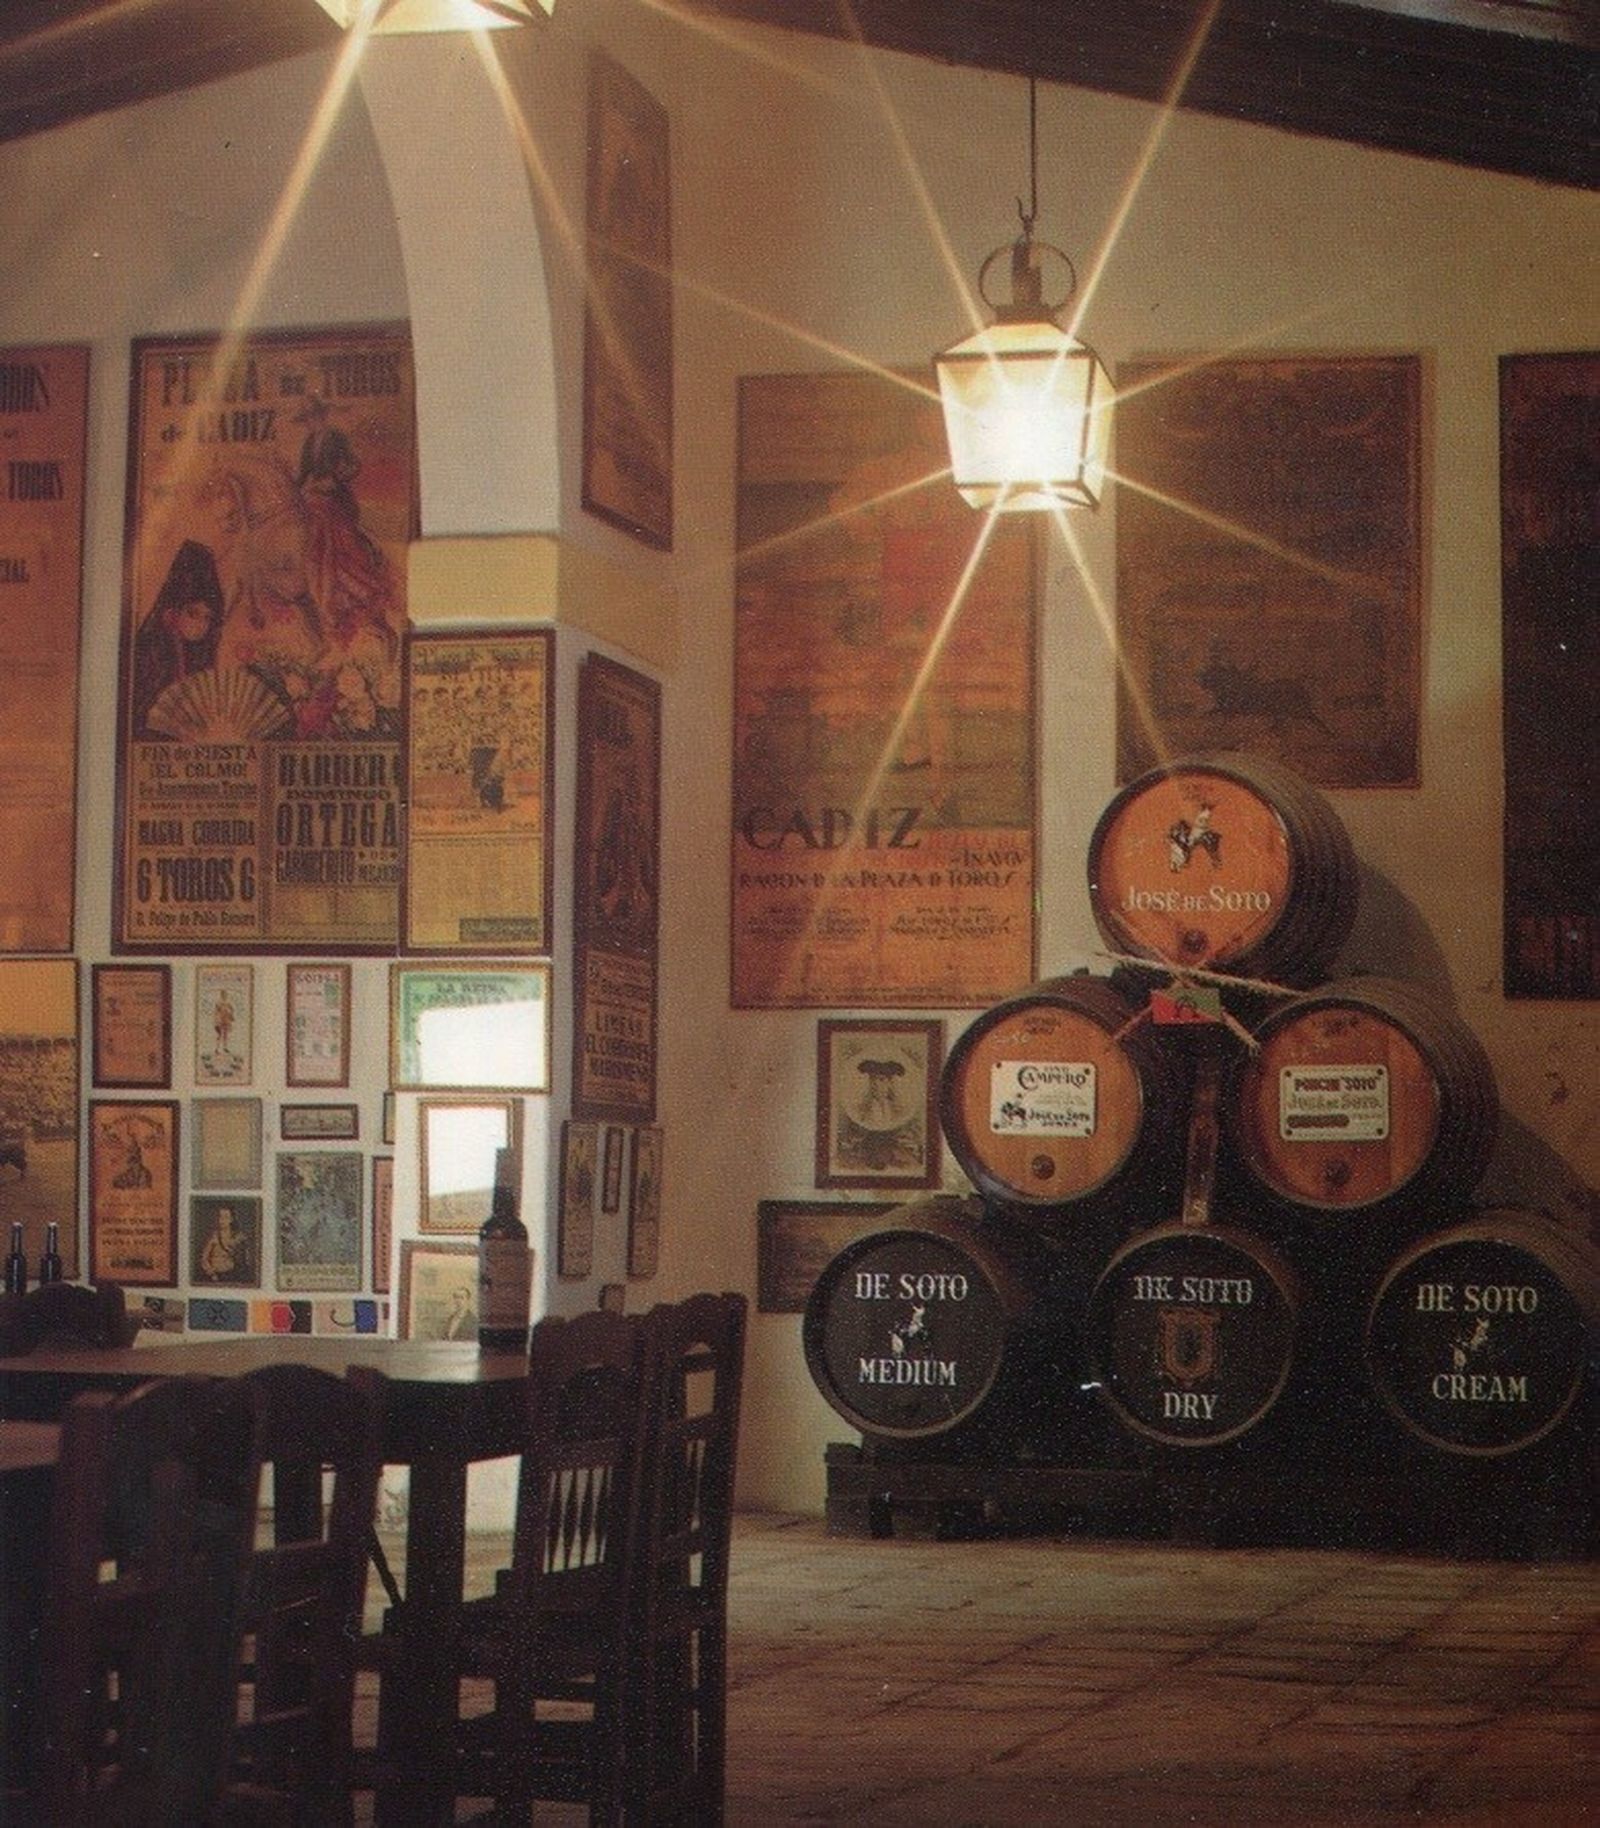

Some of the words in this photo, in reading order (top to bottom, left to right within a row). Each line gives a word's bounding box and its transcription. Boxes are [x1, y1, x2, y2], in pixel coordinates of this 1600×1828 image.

[161, 358, 259, 406] PLZA
[195, 744, 257, 761] FIESTA
[286, 789, 392, 801] DOMINGO
[193, 819, 256, 846] CORRIDA
[276, 802, 399, 847] ORTEGA
[741, 806, 922, 851] CADIZ
[137, 857, 150, 903] 6
[156, 857, 234, 903] TOROS
[240, 857, 256, 902] 6
[860, 870, 924, 889] PLAZA
[946, 868, 1014, 888] TOROS
[855, 1272, 891, 1300] DE
[899, 1273, 969, 1301] SOTO
[1416, 1283, 1455, 1311] DE
[1463, 1284, 1538, 1314] SOTO
[858, 1357, 957, 1386] MEDIUM
[1432, 1373, 1529, 1402] CREAM
[1162, 1391, 1218, 1420] DRY
